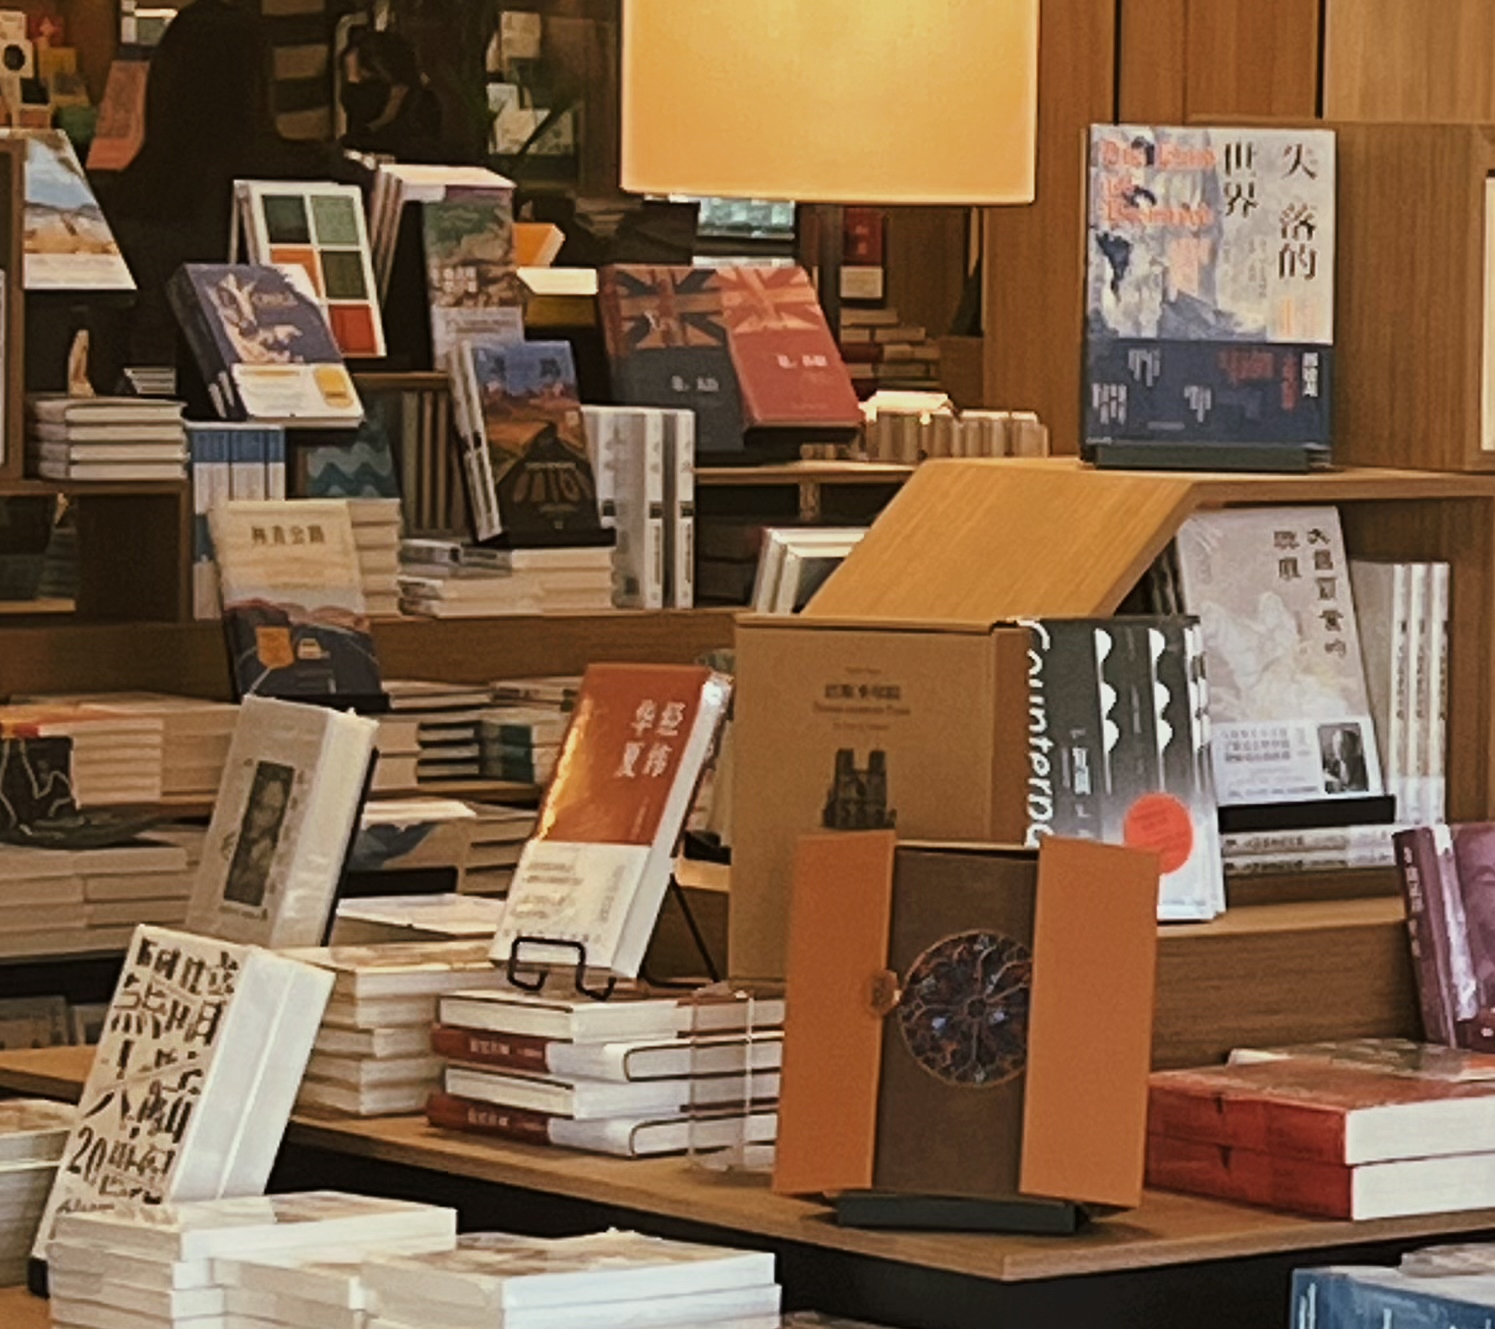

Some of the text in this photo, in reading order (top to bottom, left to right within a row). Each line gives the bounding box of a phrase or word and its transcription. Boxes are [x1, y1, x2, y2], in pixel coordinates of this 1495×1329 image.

[1223, 141, 1258, 218] 世界
[1277, 142, 1318, 281] 失落的
